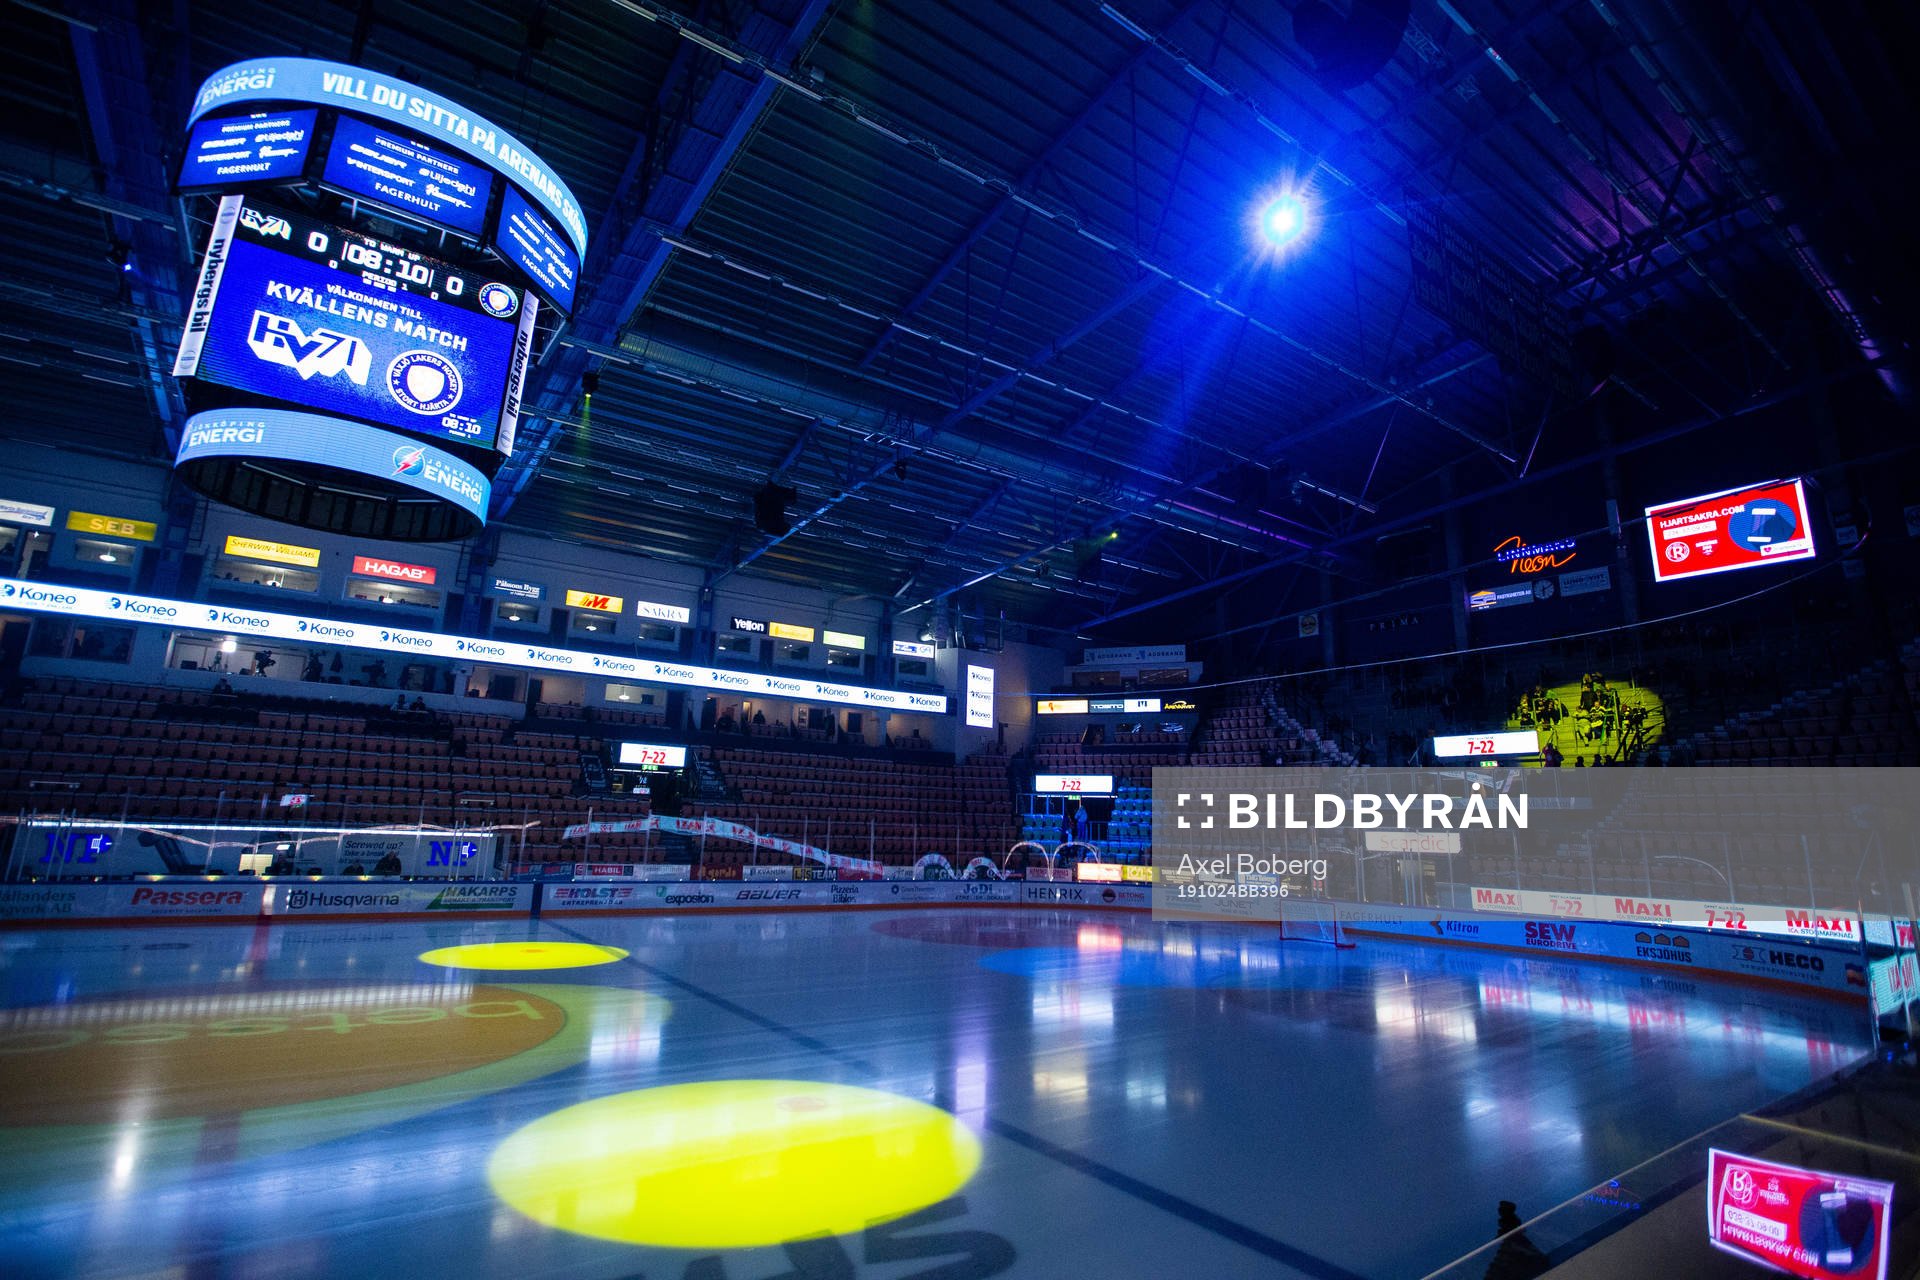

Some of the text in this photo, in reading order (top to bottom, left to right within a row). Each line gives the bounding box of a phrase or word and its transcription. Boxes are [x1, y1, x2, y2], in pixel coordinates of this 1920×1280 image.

[201, 74, 275, 105] ENERGI
[322, 72, 368, 100] VILL
[371, 83, 406, 110] DU
[408, 97, 470, 137] SITTA
[471, 125, 497, 154] PÅ
[497, 143, 563, 208] ARENANS
[375, 137, 459, 174] PREMIUM PARTNERS
[217, 162, 271, 175] FAGERHULT
[374, 182, 441, 212] FAGERHULT
[307, 231, 329, 253] 0
[328, 260, 339, 270] 0
[346, 244, 430, 285] 08:10
[189, 238, 226, 333] nybergs bil
[446, 276, 464, 296] 0
[326, 283, 423, 321] VÄLKOMMEN TILL
[266, 280, 468, 352] KVÄLLENS MATCH
[392, 352, 458, 395] VÄXJÖ LAKERS HOCKEY
[506, 330, 529, 418] nybergs bil
[395, 387, 420, 409] STORT
[441, 416, 482, 435] 08:10
[188, 427, 265, 447] ENERGI
[423, 466, 483, 505] ENERGI
[1659, 504, 1745, 529] HJARTSAKRA.COM
[89, 517, 136, 536] SEB
[230, 538, 316, 560] SHERWIN-WILLIAMS
[364, 560, 424, 580] HAGAB
[19, 585, 77, 605] Koneo
[125, 599, 177, 618] Koneo
[221, 611, 270, 629] Koneo
[310, 622, 355, 638] Koneo
[391, 632, 433, 648] Koneo
[466, 641, 505, 656] Koneo
[537, 650, 573, 664] Koneo
[601, 658, 636, 672] Koneo
[662, 667, 695, 680] Koneo
[719, 673, 749, 686] Koneo
[974, 672, 992, 682] Koneo
[773, 680, 801, 692] Koneo
[823, 686, 849, 698] Koneo
[869, 692, 895, 704] Koneo
[915, 696, 941, 708] Koneo
[974, 710, 992, 720] Koneo
[1467, 740, 1495, 754] 7-22
[641, 750, 666, 764] 7-22
[1061, 780, 1081, 791] 7-22
[345, 839, 404, 850] Screwed up?
[1380, 834, 1446, 852] Scandic
[131, 887, 244, 906] Passera
[310, 892, 400, 909] Husqvarna
[445, 886, 518, 898] HAKARPS
[567, 887, 619, 899] HOLST
[736, 889, 802, 900] BAUER
[1027, 887, 1083, 901] HENRIX
[1550, 899, 1584, 916] 7-22
[1614, 898, 1672, 918] MAXI
[1446, 920, 1479, 935] Kitron
[1705, 910, 1748, 930] 7-22
[1785, 909, 1852, 933] MAXI
[1524, 921, 1576, 942] SEW
[1525, 938, 1577, 950] EURODRIVE
[1636, 945, 1693, 963] EKSJÖHUS
[1769, 949, 1825, 972] HECO
